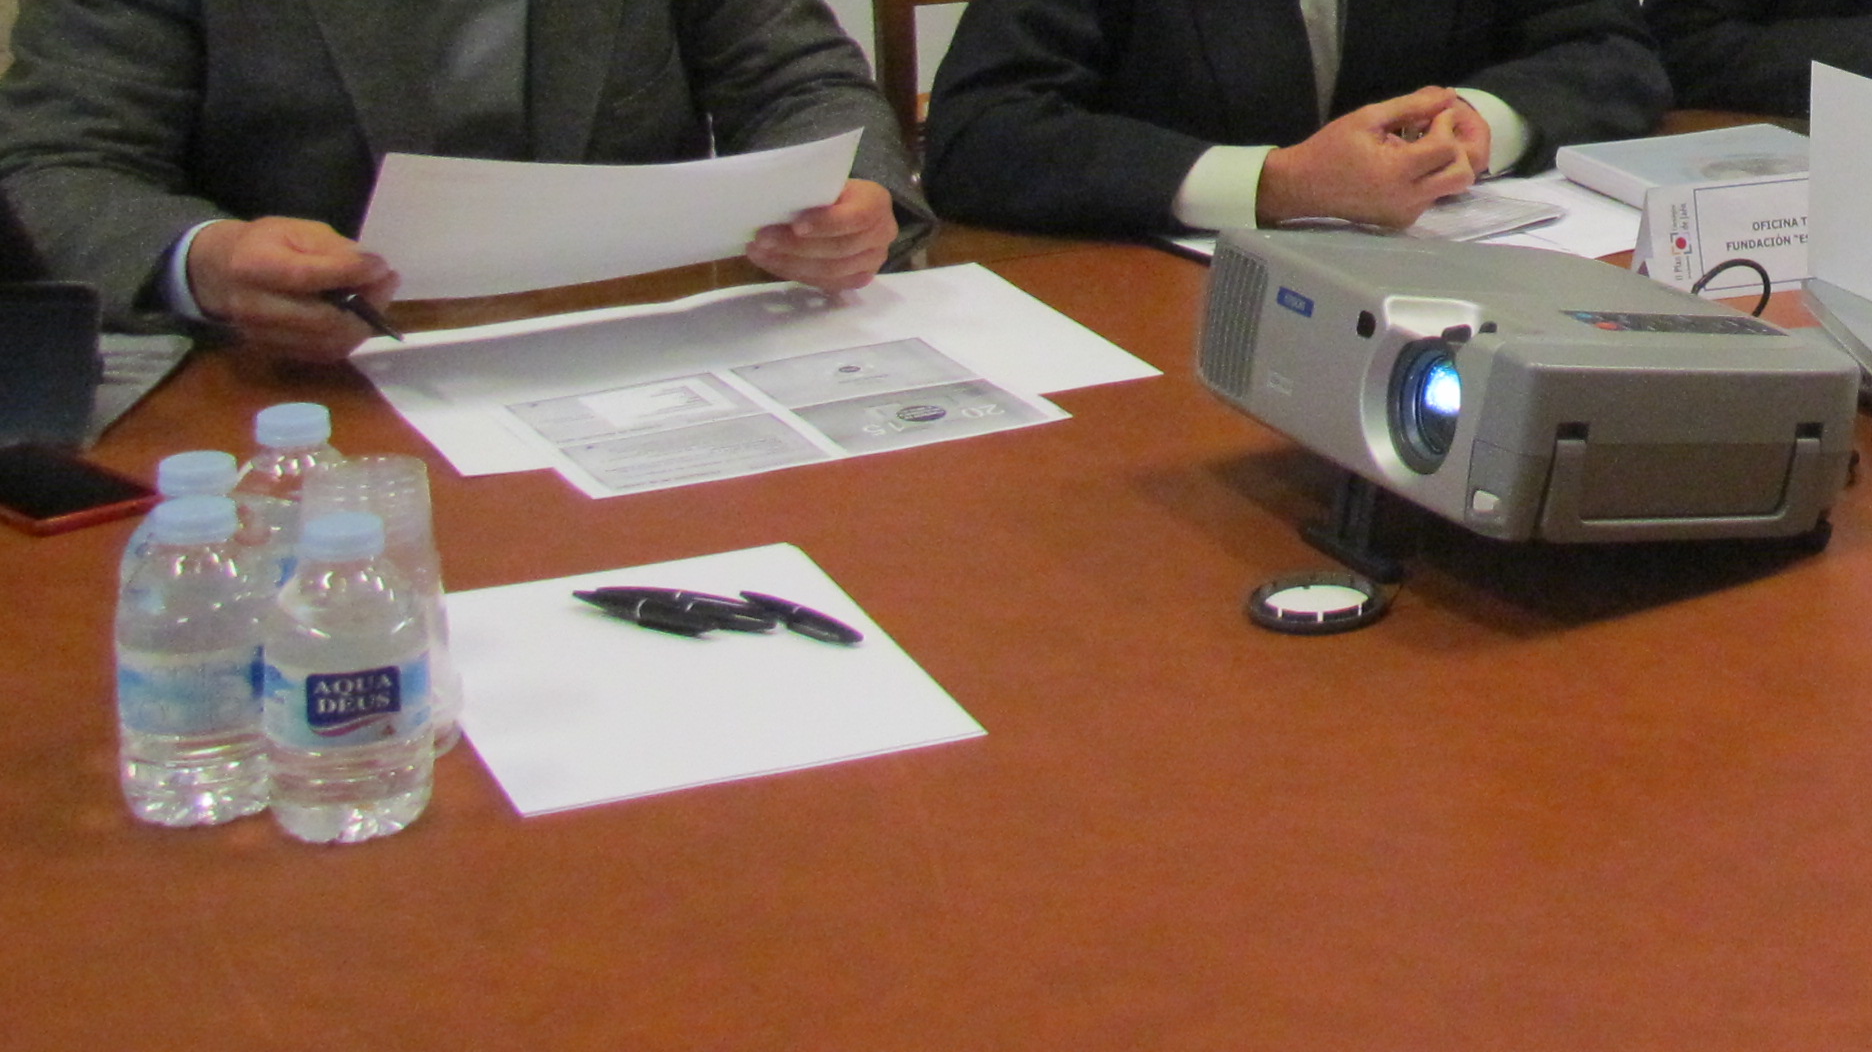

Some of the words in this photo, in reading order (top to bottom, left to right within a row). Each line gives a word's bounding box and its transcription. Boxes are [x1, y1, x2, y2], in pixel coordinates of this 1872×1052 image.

[1752, 219, 1799, 232] OFICINA
[1726, 235, 1791, 252] FUNDACIÓN
[314, 673, 393, 695] AQUA
[316, 694, 391, 714] DEUS
